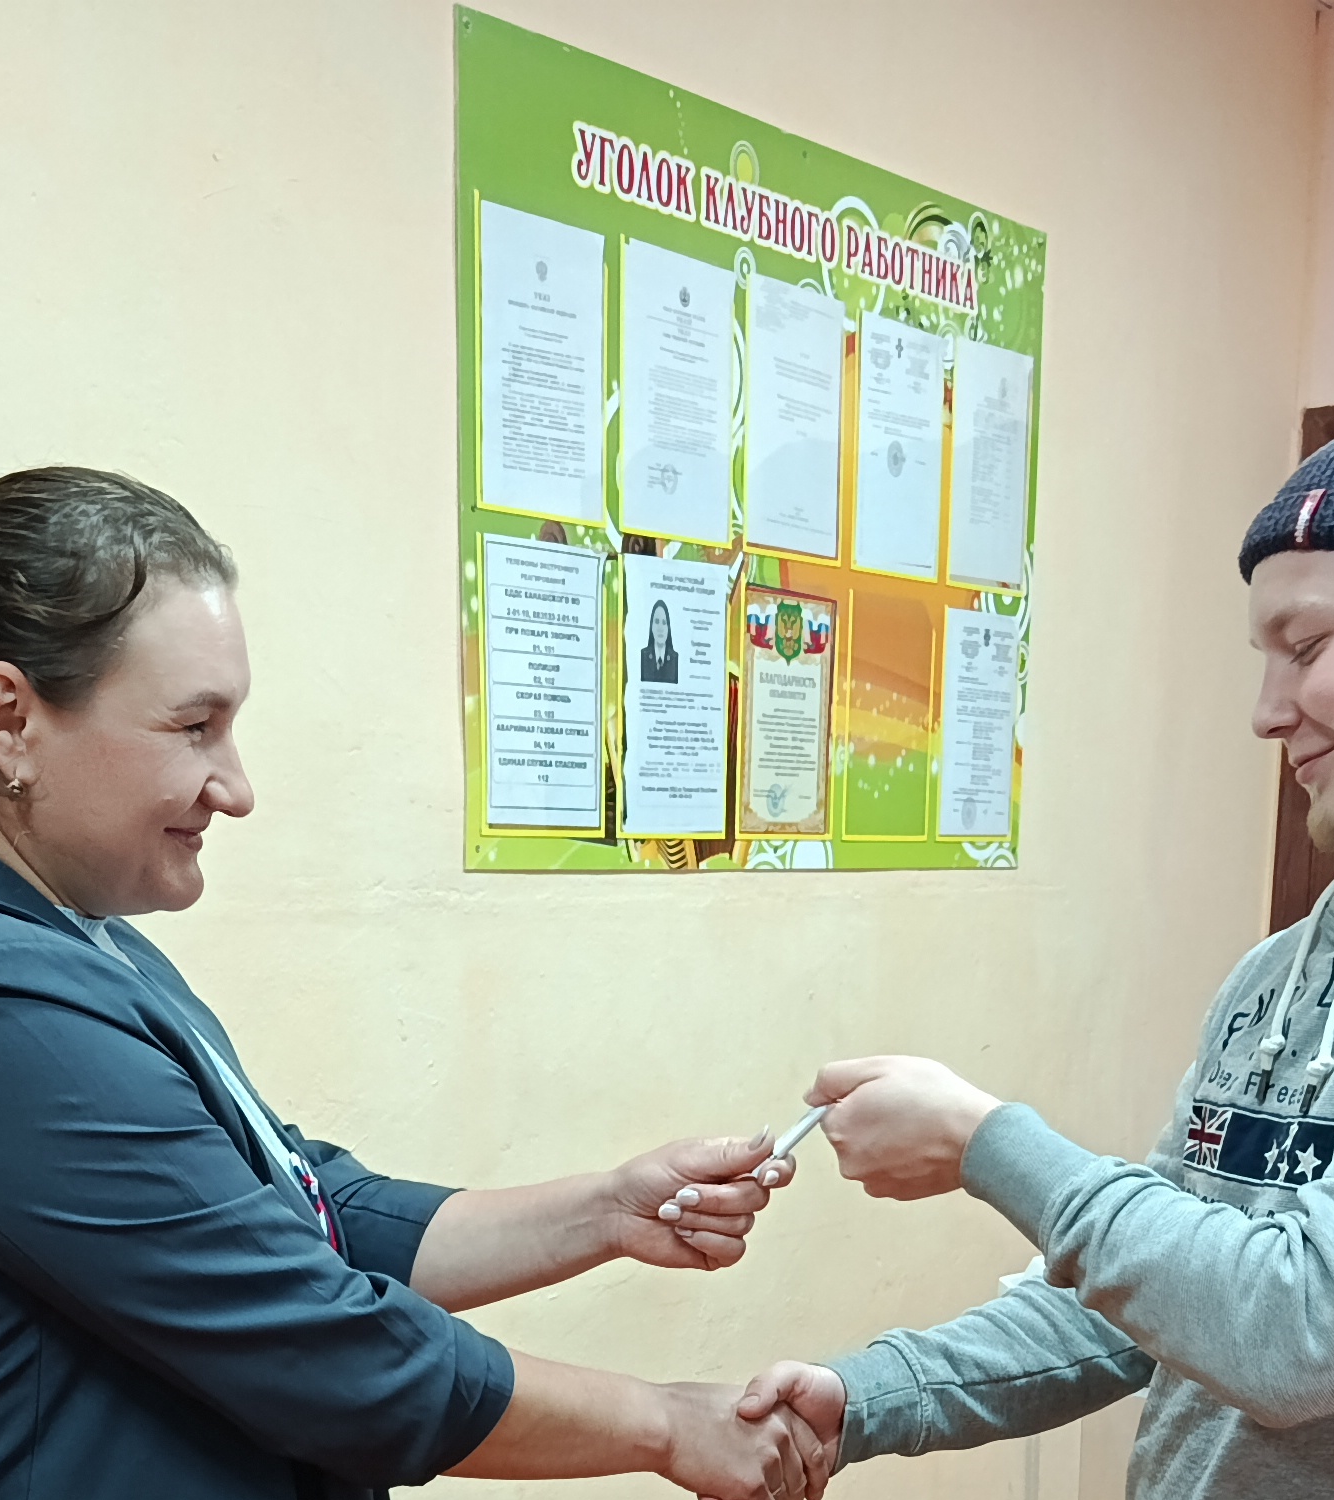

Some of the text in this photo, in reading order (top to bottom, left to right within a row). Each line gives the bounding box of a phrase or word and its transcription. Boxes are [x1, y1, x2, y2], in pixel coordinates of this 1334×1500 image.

[576, 126, 694, 218] УГОЛОК
[704, 173, 837, 264] КЛУБНОГО
[846, 225, 977, 311] РАБОТНИКА
